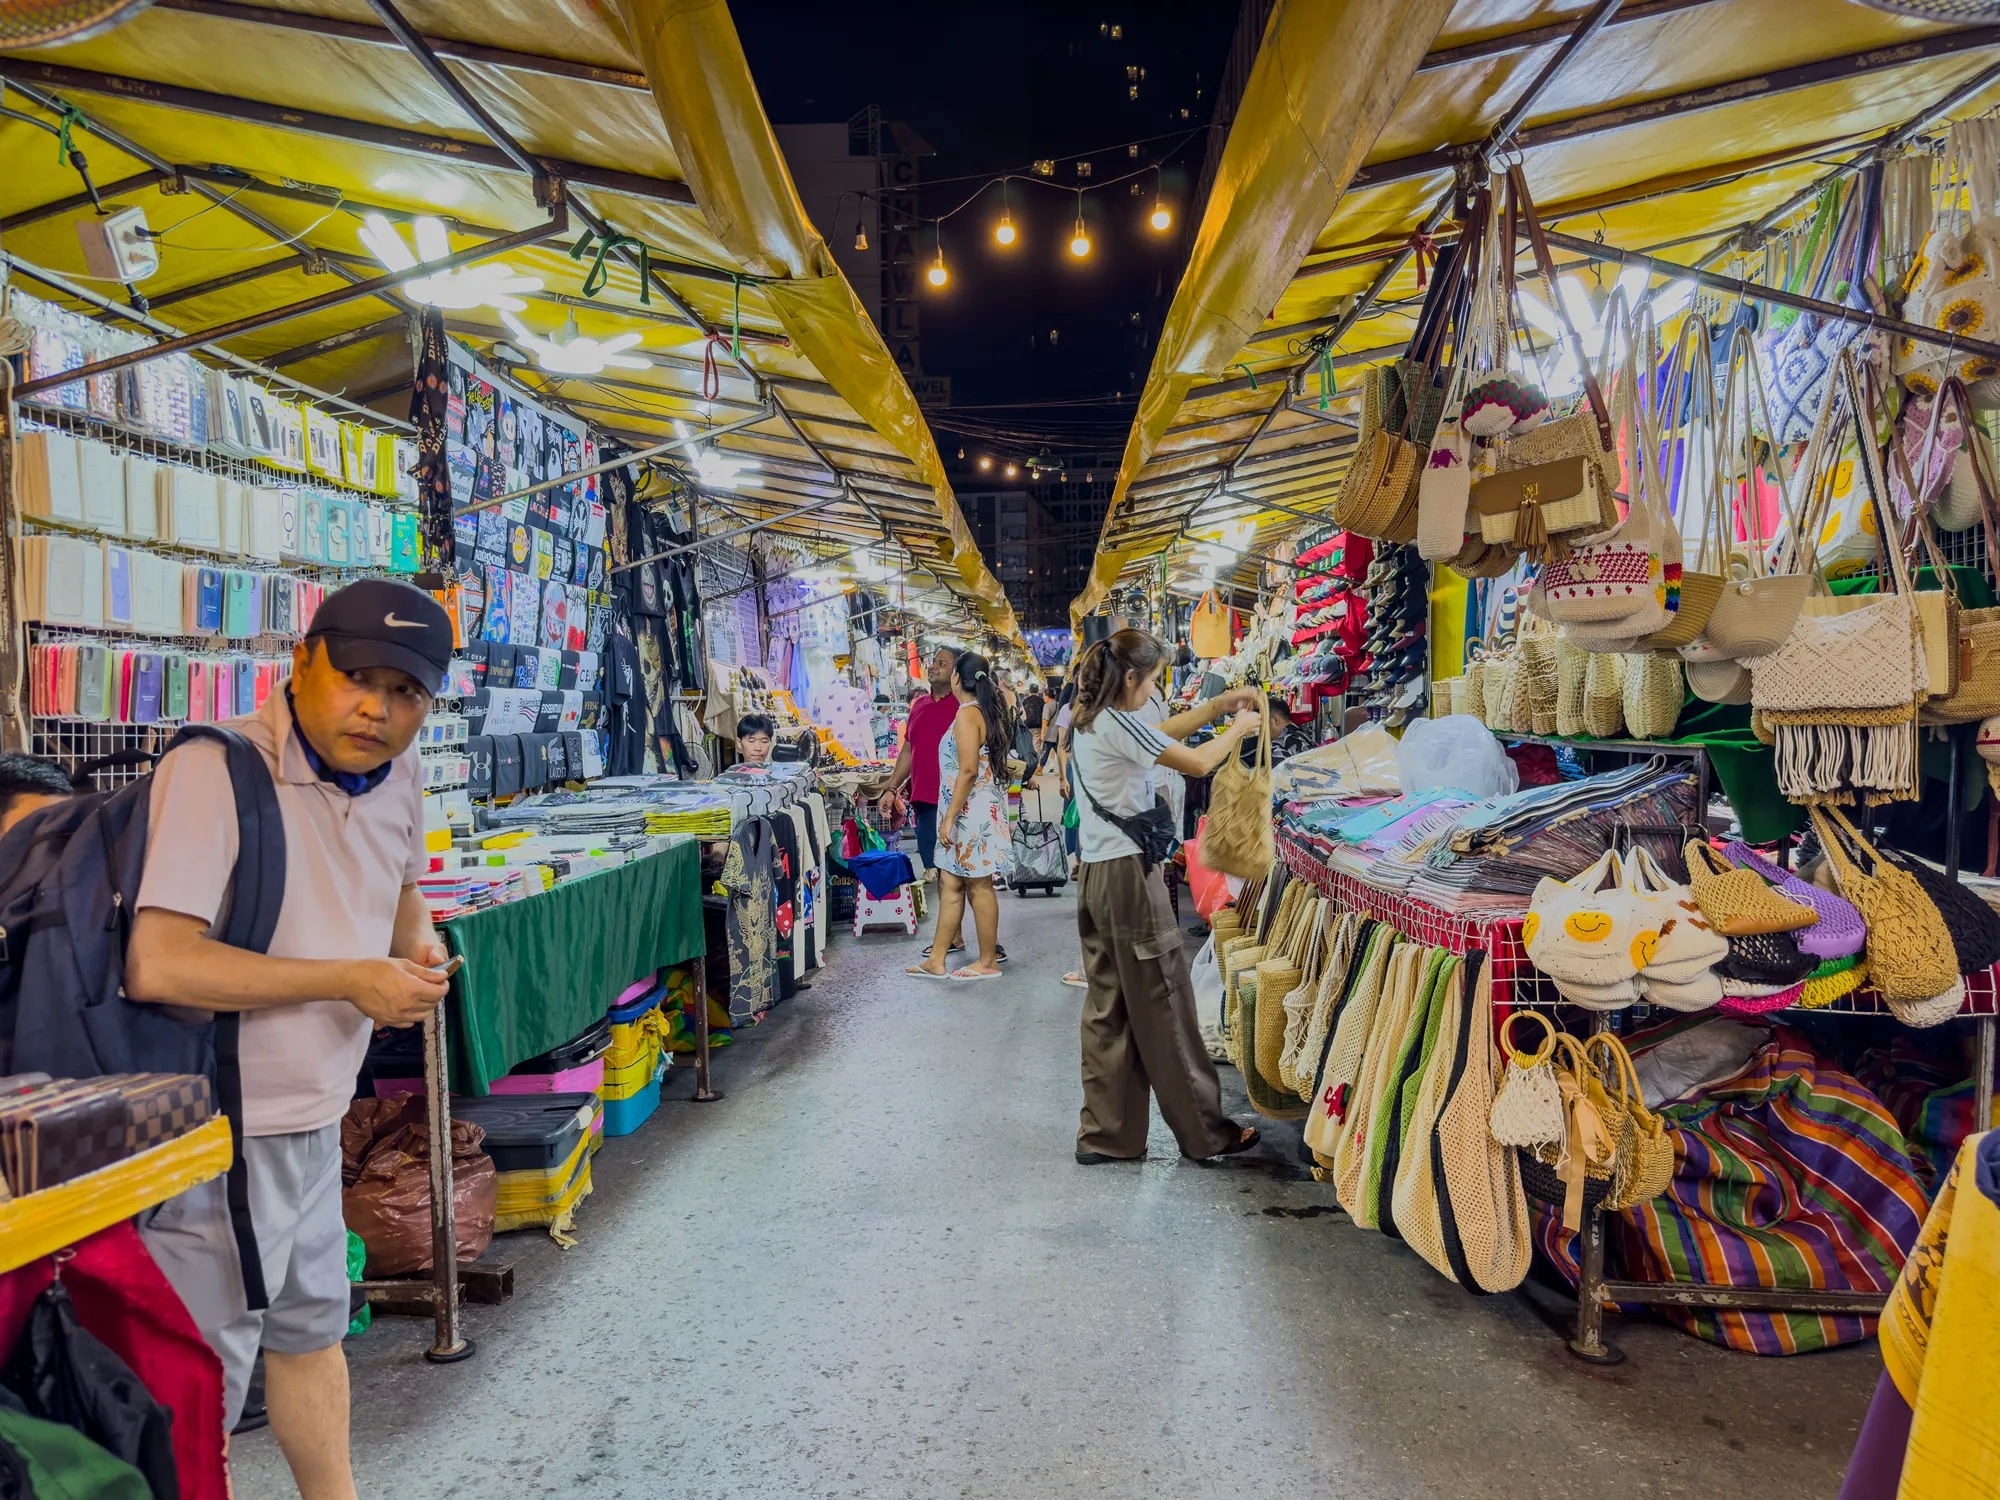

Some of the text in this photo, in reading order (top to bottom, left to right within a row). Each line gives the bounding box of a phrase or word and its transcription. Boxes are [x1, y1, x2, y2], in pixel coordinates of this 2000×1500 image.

[893, 160, 917, 367] CHAWLA
[909, 381, 947, 394] AVEL
[450, 480, 470, 496] atagonia
